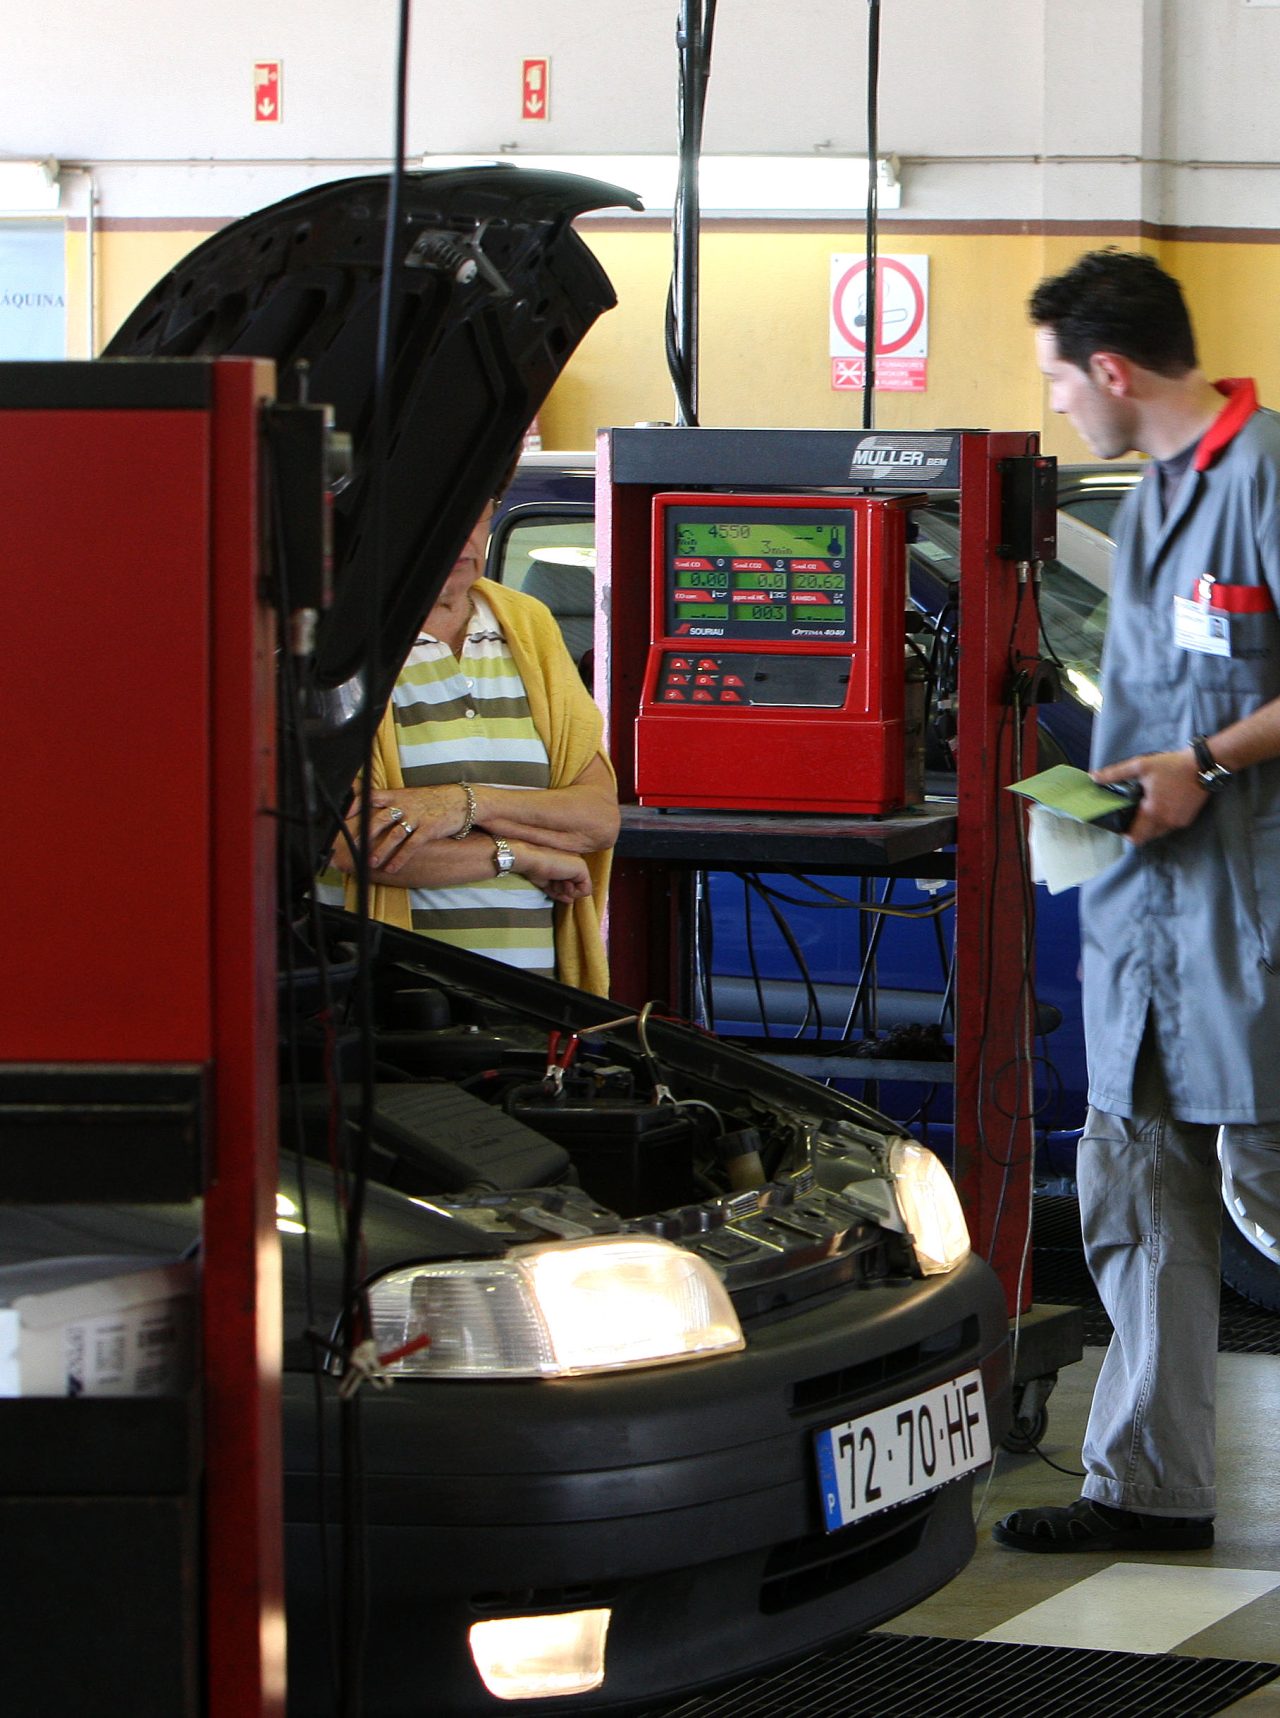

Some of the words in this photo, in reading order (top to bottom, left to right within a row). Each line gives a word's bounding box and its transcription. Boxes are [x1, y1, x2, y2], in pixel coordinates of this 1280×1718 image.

[852, 450, 924, 466] MULLER
[708, 525, 751, 539] 4550
[691, 573, 728, 587] 0.00
[758, 574, 785, 588] 0.0
[797, 575, 845, 589] 20.62
